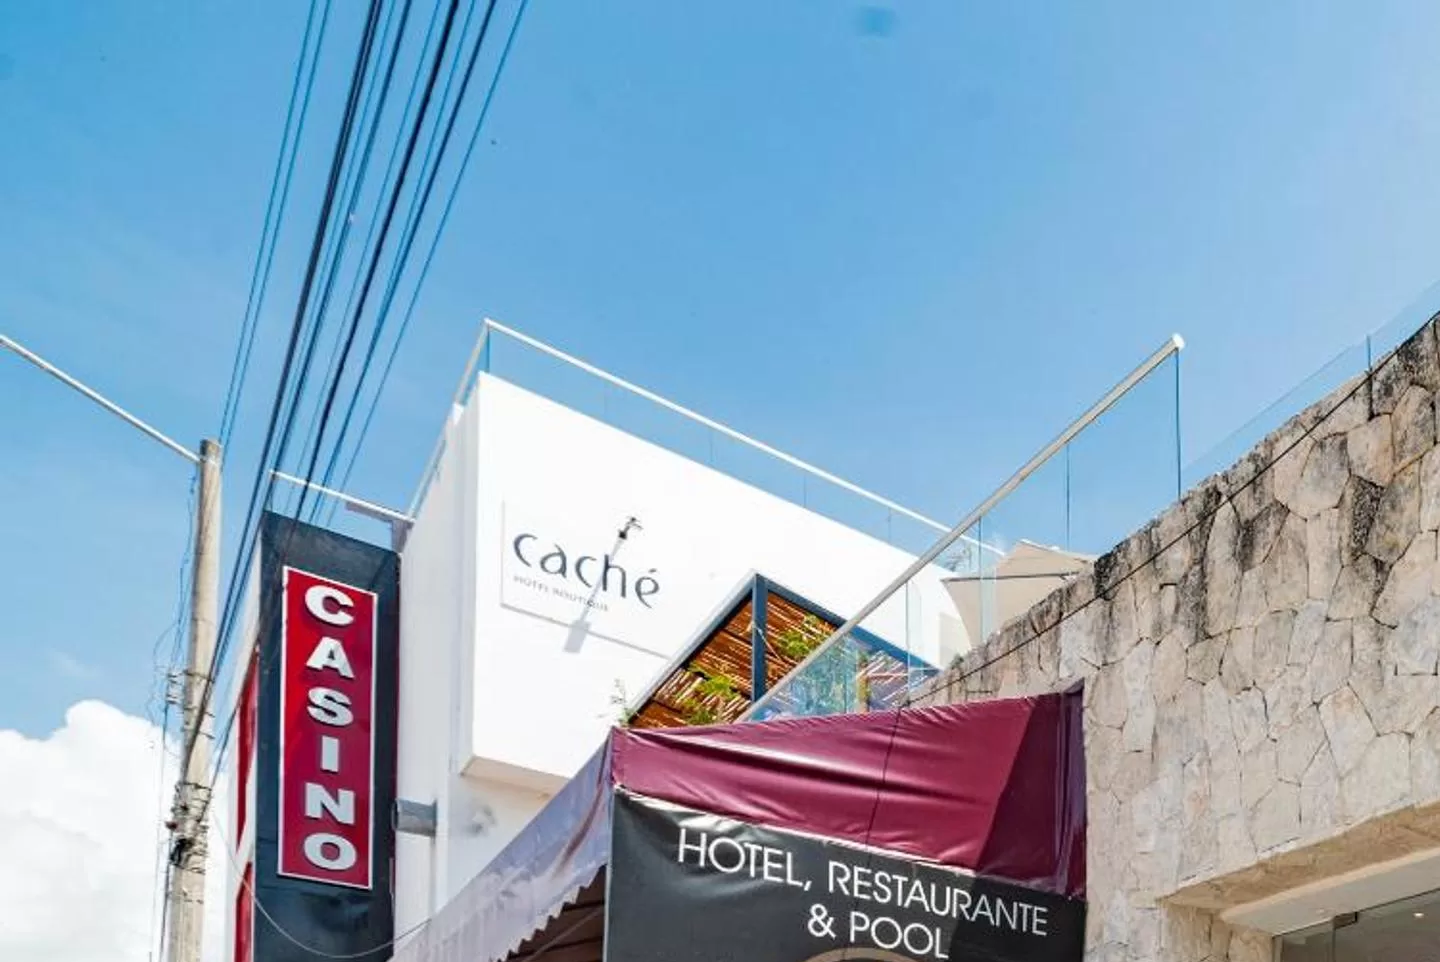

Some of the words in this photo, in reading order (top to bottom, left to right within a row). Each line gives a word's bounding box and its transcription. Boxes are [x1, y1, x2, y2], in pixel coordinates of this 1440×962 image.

[513, 533, 660, 609] caché
[303, 585, 358, 871] CASINO
[678, 828, 812, 891] HOTEL,
[828, 861, 1048, 936] RESTAURANTE
[807, 903, 837, 940] &
[850, 911, 949, 959] POOL
